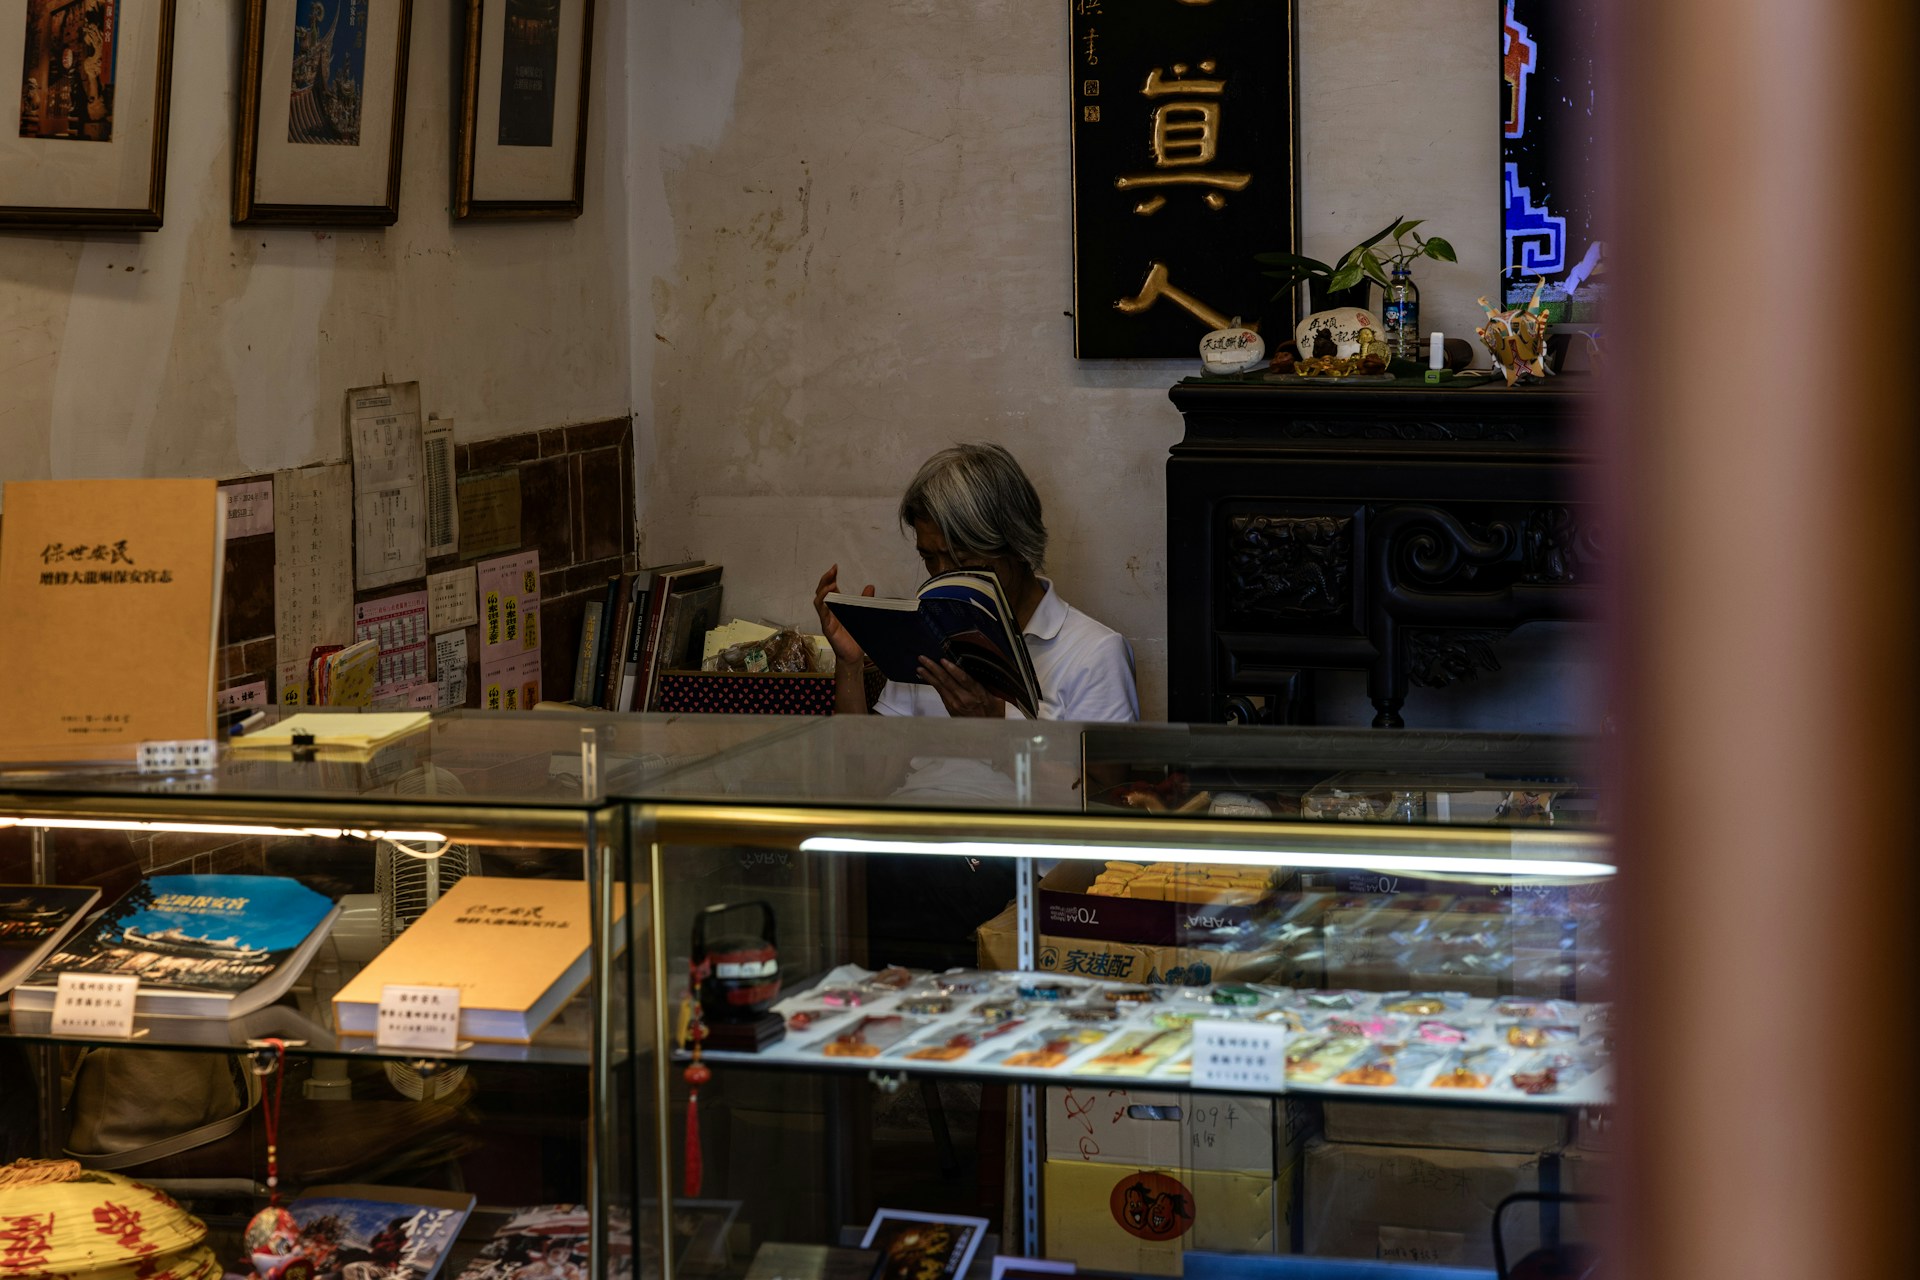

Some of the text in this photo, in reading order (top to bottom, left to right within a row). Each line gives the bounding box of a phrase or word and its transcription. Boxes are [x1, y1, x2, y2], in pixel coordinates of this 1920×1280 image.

[1113, 0, 1260, 336] 真人
[40, 539, 134, 565] 保世安民
[1066, 914, 1078, 923] A4
[1078, 907, 1100, 925] 70
[1064, 950, 1135, 978] 家速配
